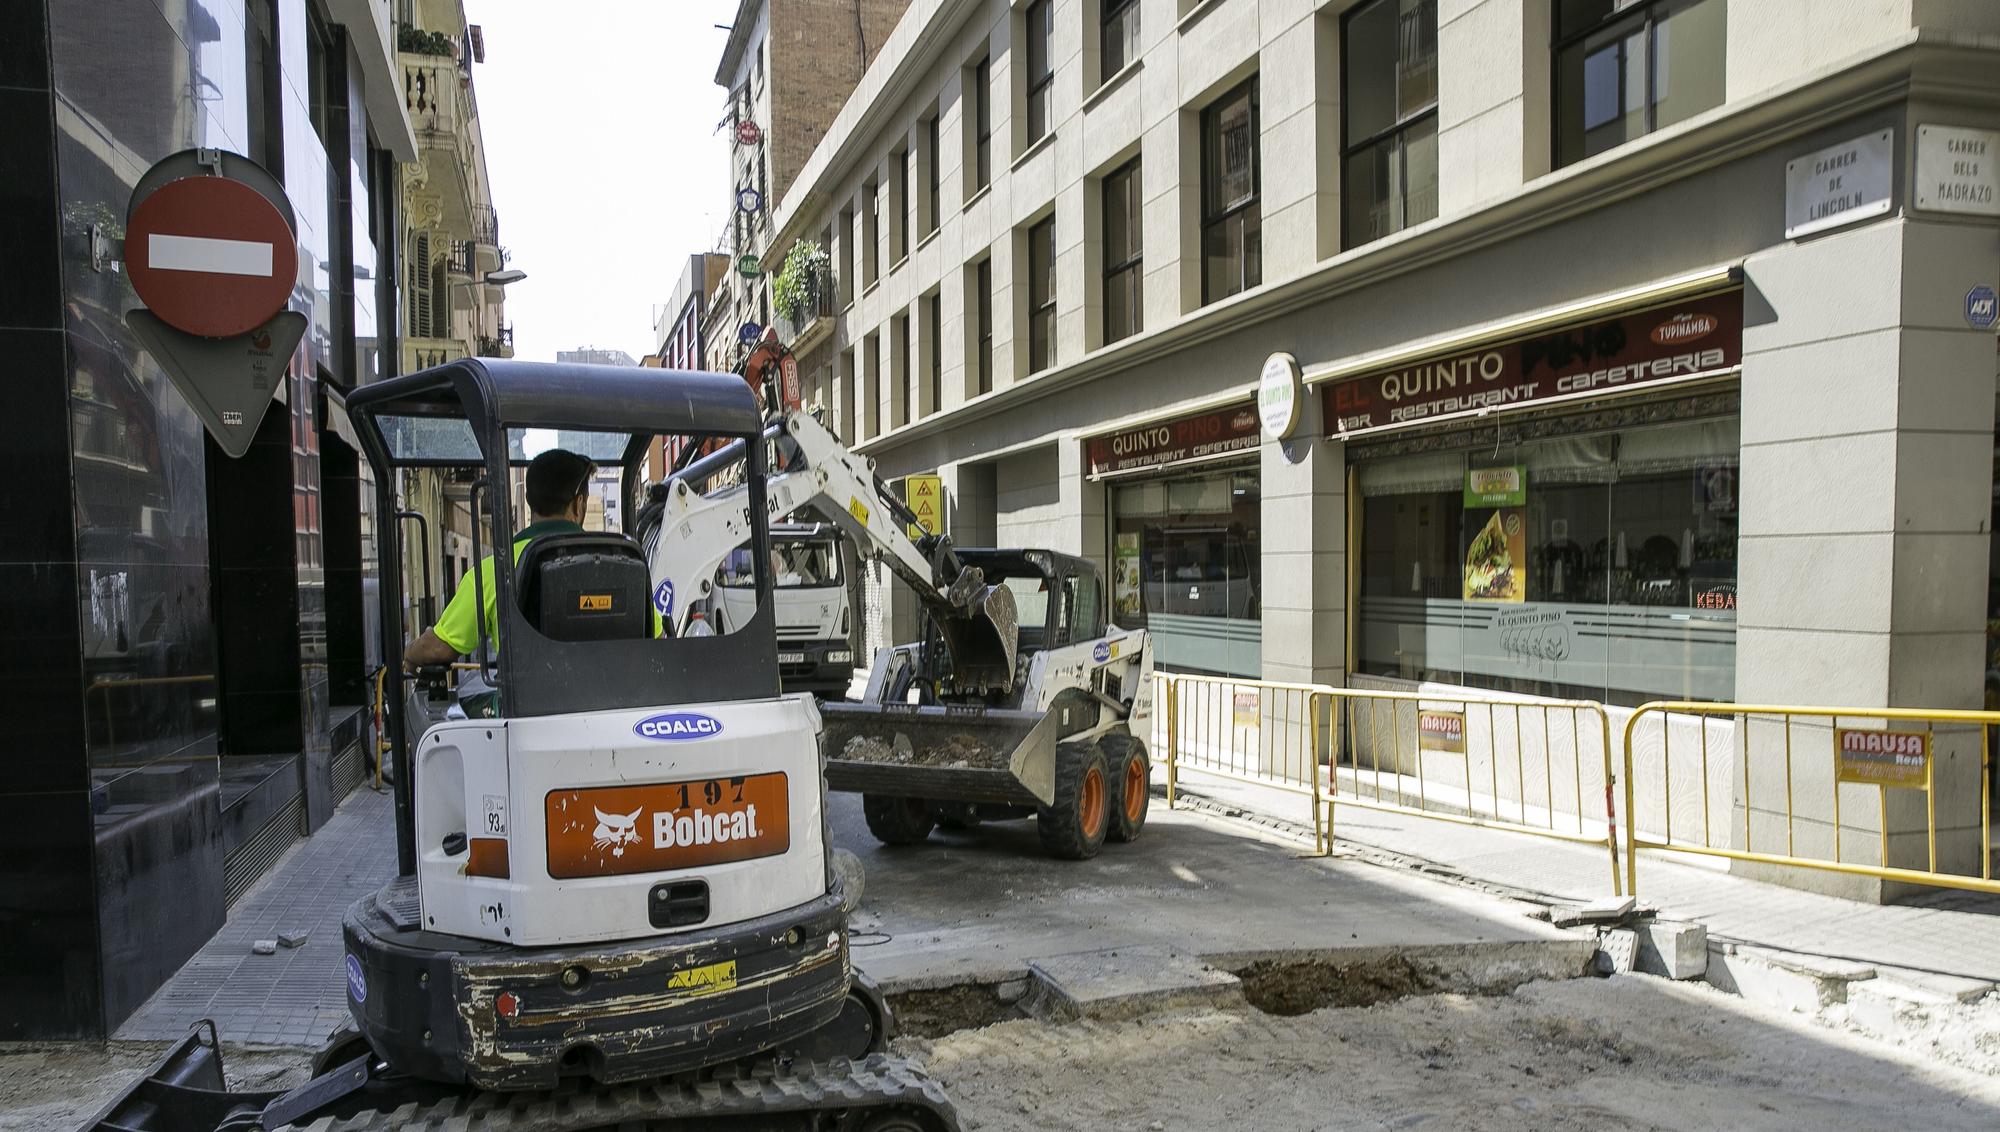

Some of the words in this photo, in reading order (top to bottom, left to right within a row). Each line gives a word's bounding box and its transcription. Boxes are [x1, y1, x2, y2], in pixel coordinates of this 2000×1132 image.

[1948, 140, 1985, 156] CARRER
[1815, 151, 1857, 176] CARRER
[1953, 162, 1978, 177] DELS
[1829, 176, 1842, 192] DE
[1938, 183, 1992, 203] MADRAZO
[1809, 192, 1863, 222] LINCOLN
[1970, 298, 1994, 316] ADT
[1659, 318, 1711, 341] TUPINAMBA
[1336, 383, 1369, 411] EL
[1381, 352, 1504, 402] QUINTO
[1391, 382, 1539, 422] RESTAURANT
[1557, 348, 1724, 392] CAFETERIA
[1113, 426, 1170, 457] QUINTO
[1176, 415, 1221, 443] PINO
[1697, 592, 1737, 610] KEBA
[1508, 614, 1539, 626] QUINTO
[1540, 612, 1561, 623] PINO
[642, 719, 717, 736] COALCI
[1421, 715, 1461, 732] MAUSA
[1844, 731, 1922, 755] MAUSA
[1895, 753, 1926, 768] Rent
[653, 803, 757, 850] Bobcat
